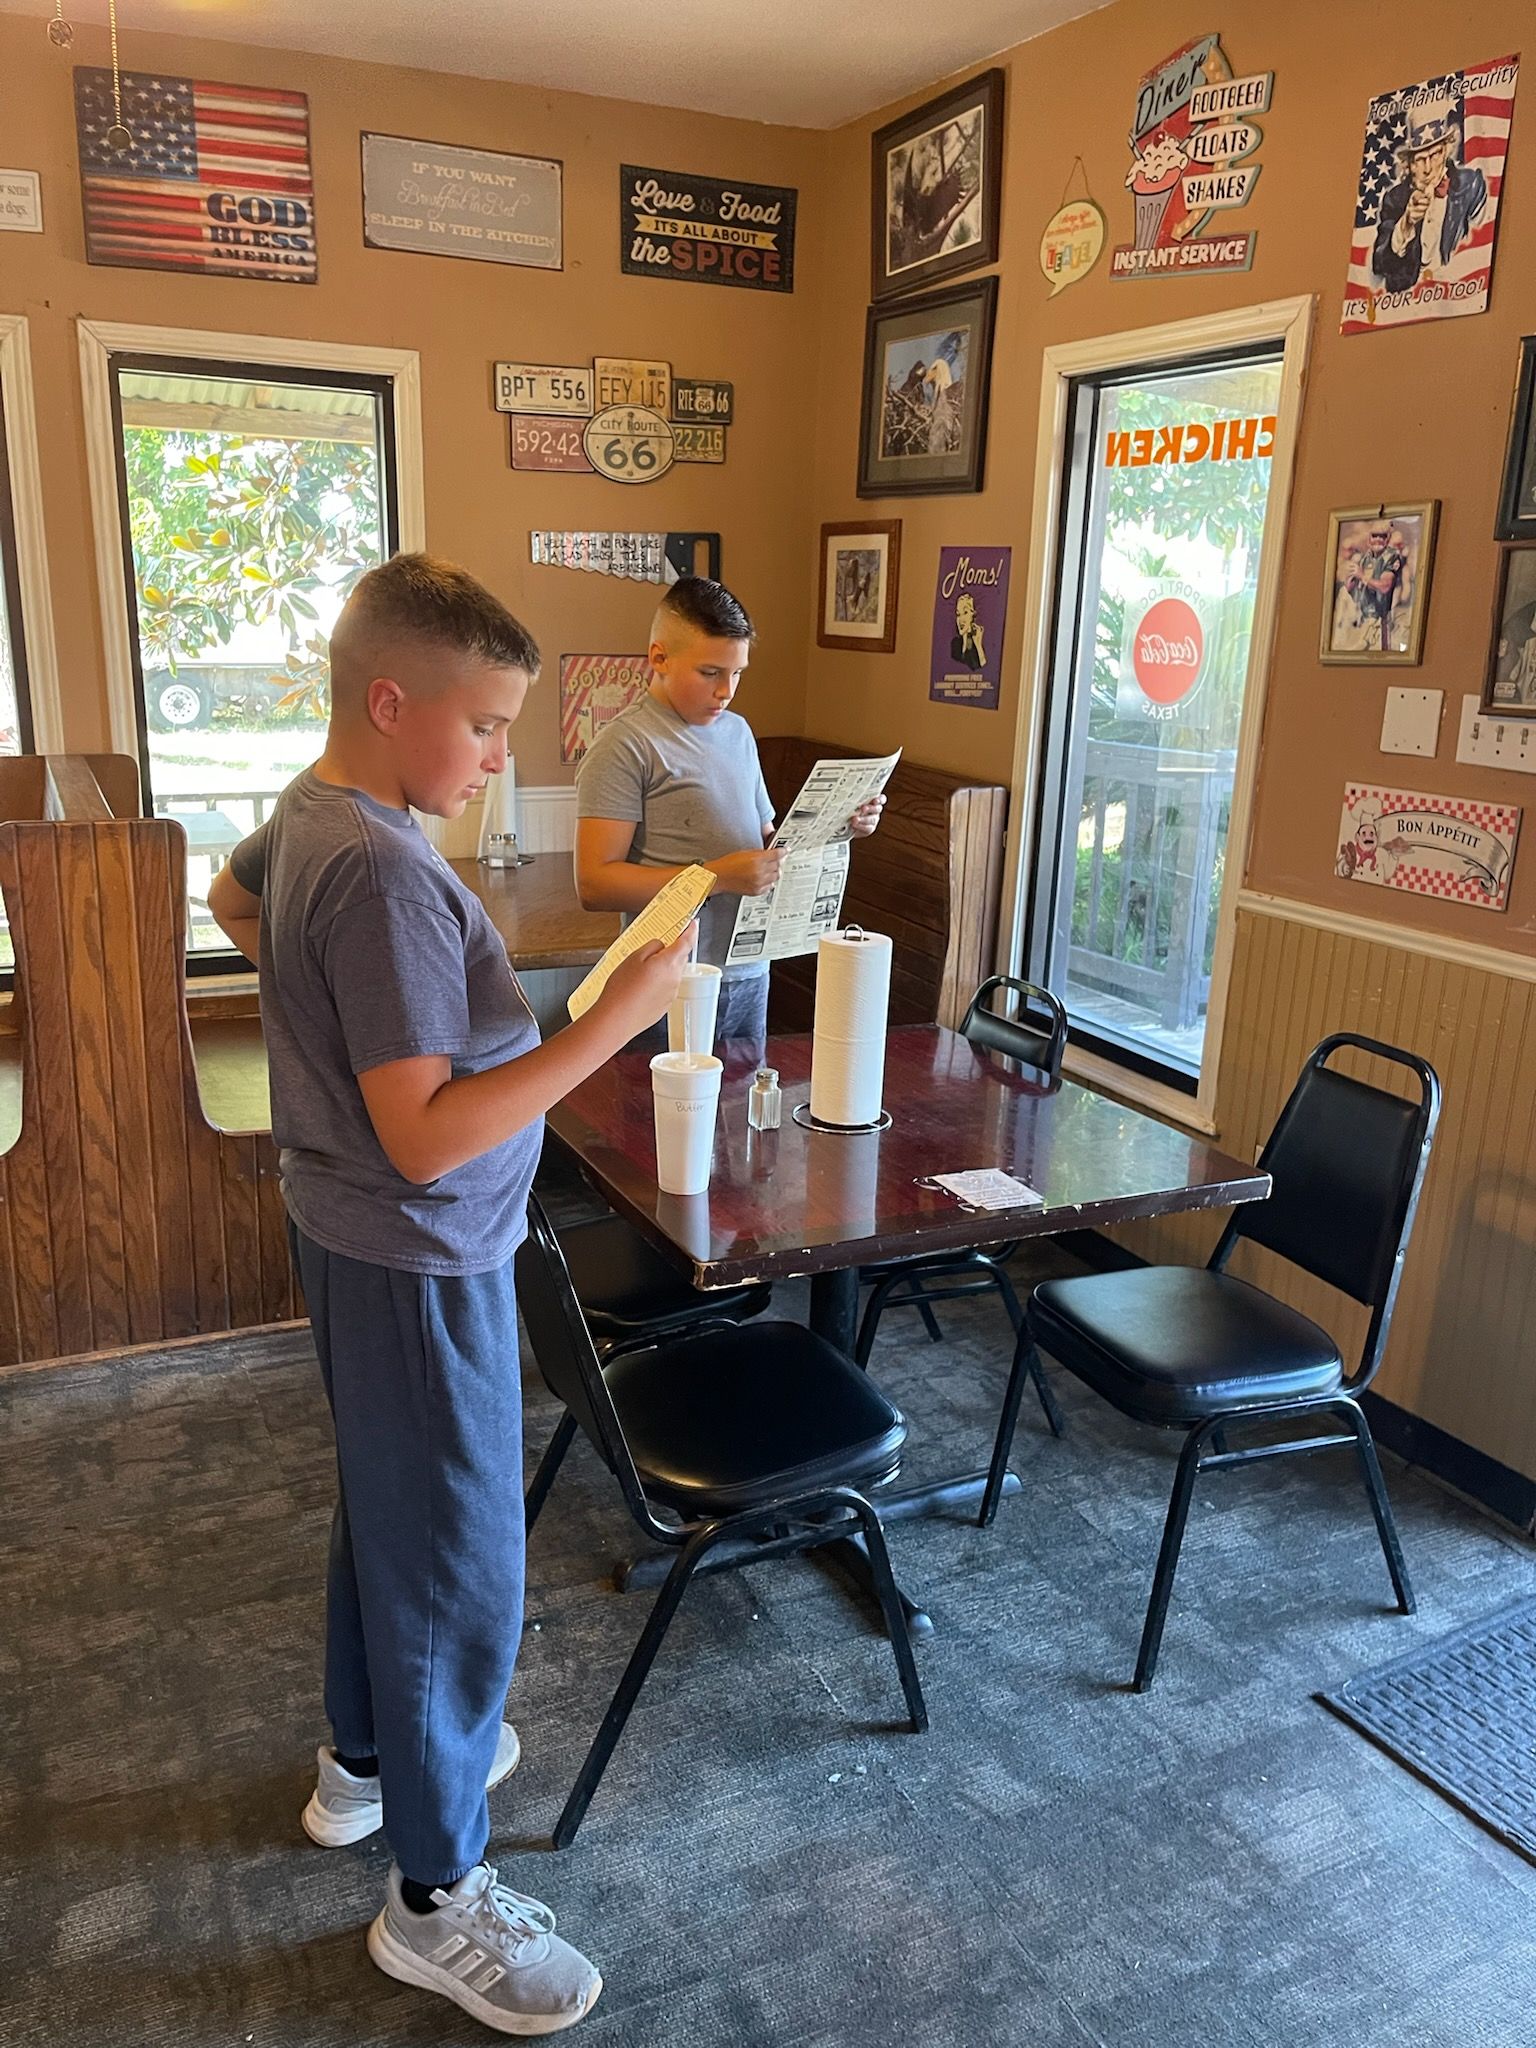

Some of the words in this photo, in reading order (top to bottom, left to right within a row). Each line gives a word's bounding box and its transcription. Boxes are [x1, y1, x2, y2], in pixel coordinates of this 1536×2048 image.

[1136, 53, 1207, 135] Diner
[1191, 80, 1265, 116] ROOTBEER
[1369, 82, 1448, 121] Homeland
[1193, 128, 1249, 159] FLOATS
[412, 162, 430, 174] IF
[432, 166, 466, 180] YOU
[469, 171, 517, 189] WANT
[1187, 175, 1247, 204] SHAKES
[207, 192, 307, 230] GOD
[631, 179, 696, 215] Love
[700, 197, 715, 215] &
[719, 191, 782, 226] Food
[209, 225, 309, 251] BLESS
[368, 212, 424, 231] SLEEP
[428, 219, 446, 233] IN
[449, 223, 483, 239] THE
[485, 228, 556, 249] KITCHEN
[682, 224, 708, 239] ALL
[711, 230, 759, 246] ABOUT
[212, 247, 308, 266] AMERICA
[630, 235, 671, 265] the
[671, 239, 781, 282] SPICE
[1114, 246, 1181, 271] INSTANT
[1179, 240, 1247, 266] SERVICE
[1373, 291, 1413, 311] YOUR
[501, 375, 537, 399] BPT
[551, 378, 586, 402] 556
[641, 379, 667, 409] 115
[677, 388, 695, 411] RTE
[716, 391, 730, 414] 66
[600, 420, 623, 431] CITY
[627, 420, 661, 433] ROUTE
[696, 429, 724, 451] 216
[603, 438, 657, 470] 66
[942, 556, 1004, 600] Moms!
